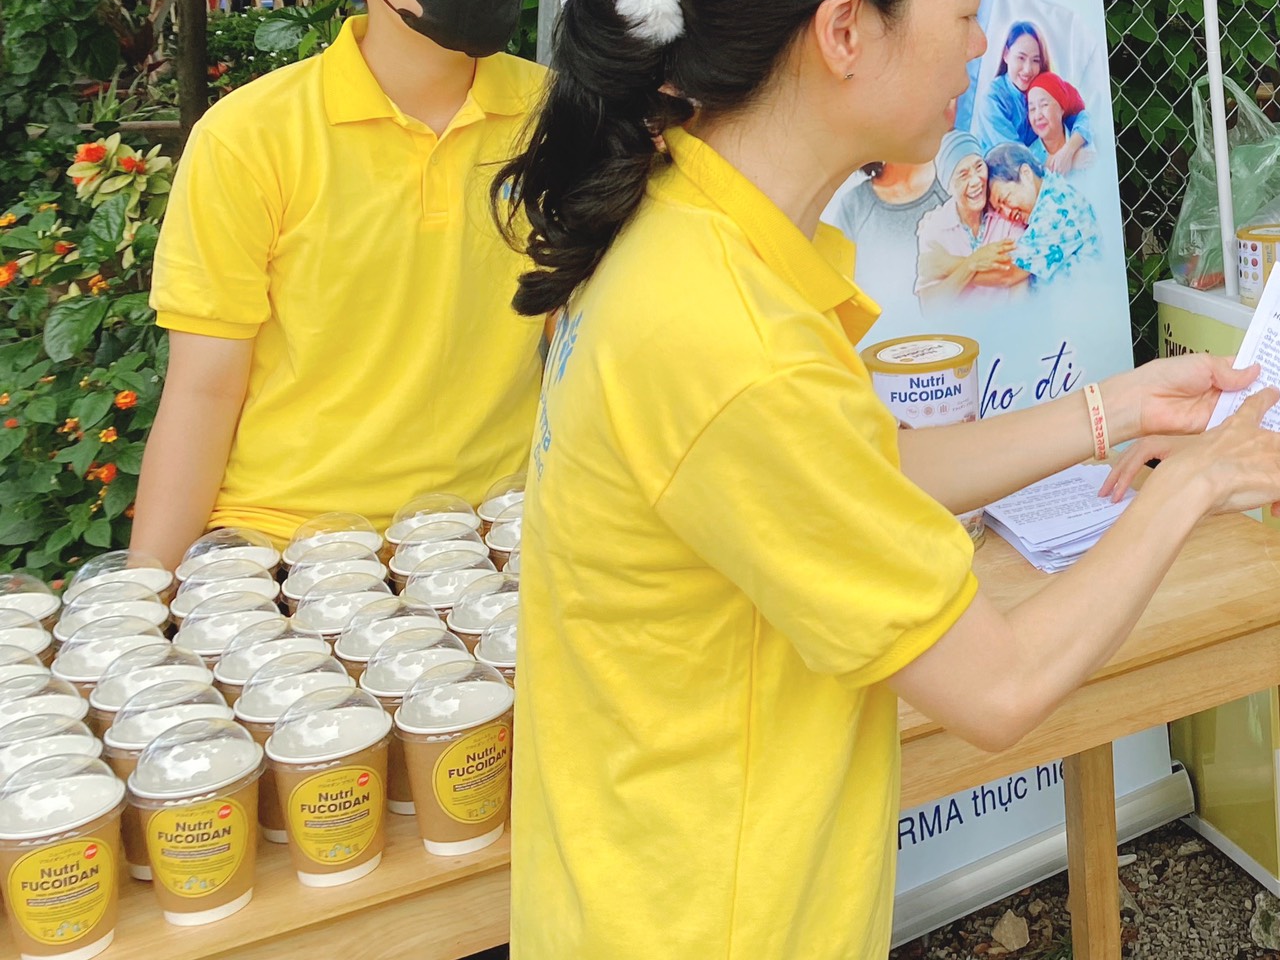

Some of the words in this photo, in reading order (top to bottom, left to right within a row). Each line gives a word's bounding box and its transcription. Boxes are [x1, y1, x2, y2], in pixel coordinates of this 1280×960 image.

[909, 374, 945, 389] Nutri
[890, 384, 962, 403] FUCOIDAN
[448, 746, 507, 778] FUCOIDAN
[466, 743, 496, 763] Nutri
[301, 792, 370, 814] FUCOIDAN
[318, 787, 353, 802] Nutri
[972, 776, 1028, 817] thực
[158, 826, 231, 843] FUCOIDAN
[175, 819, 213, 832] Nutri
[21, 864, 99, 891] FUCOIDAN
[40, 861, 80, 879] Nutri
